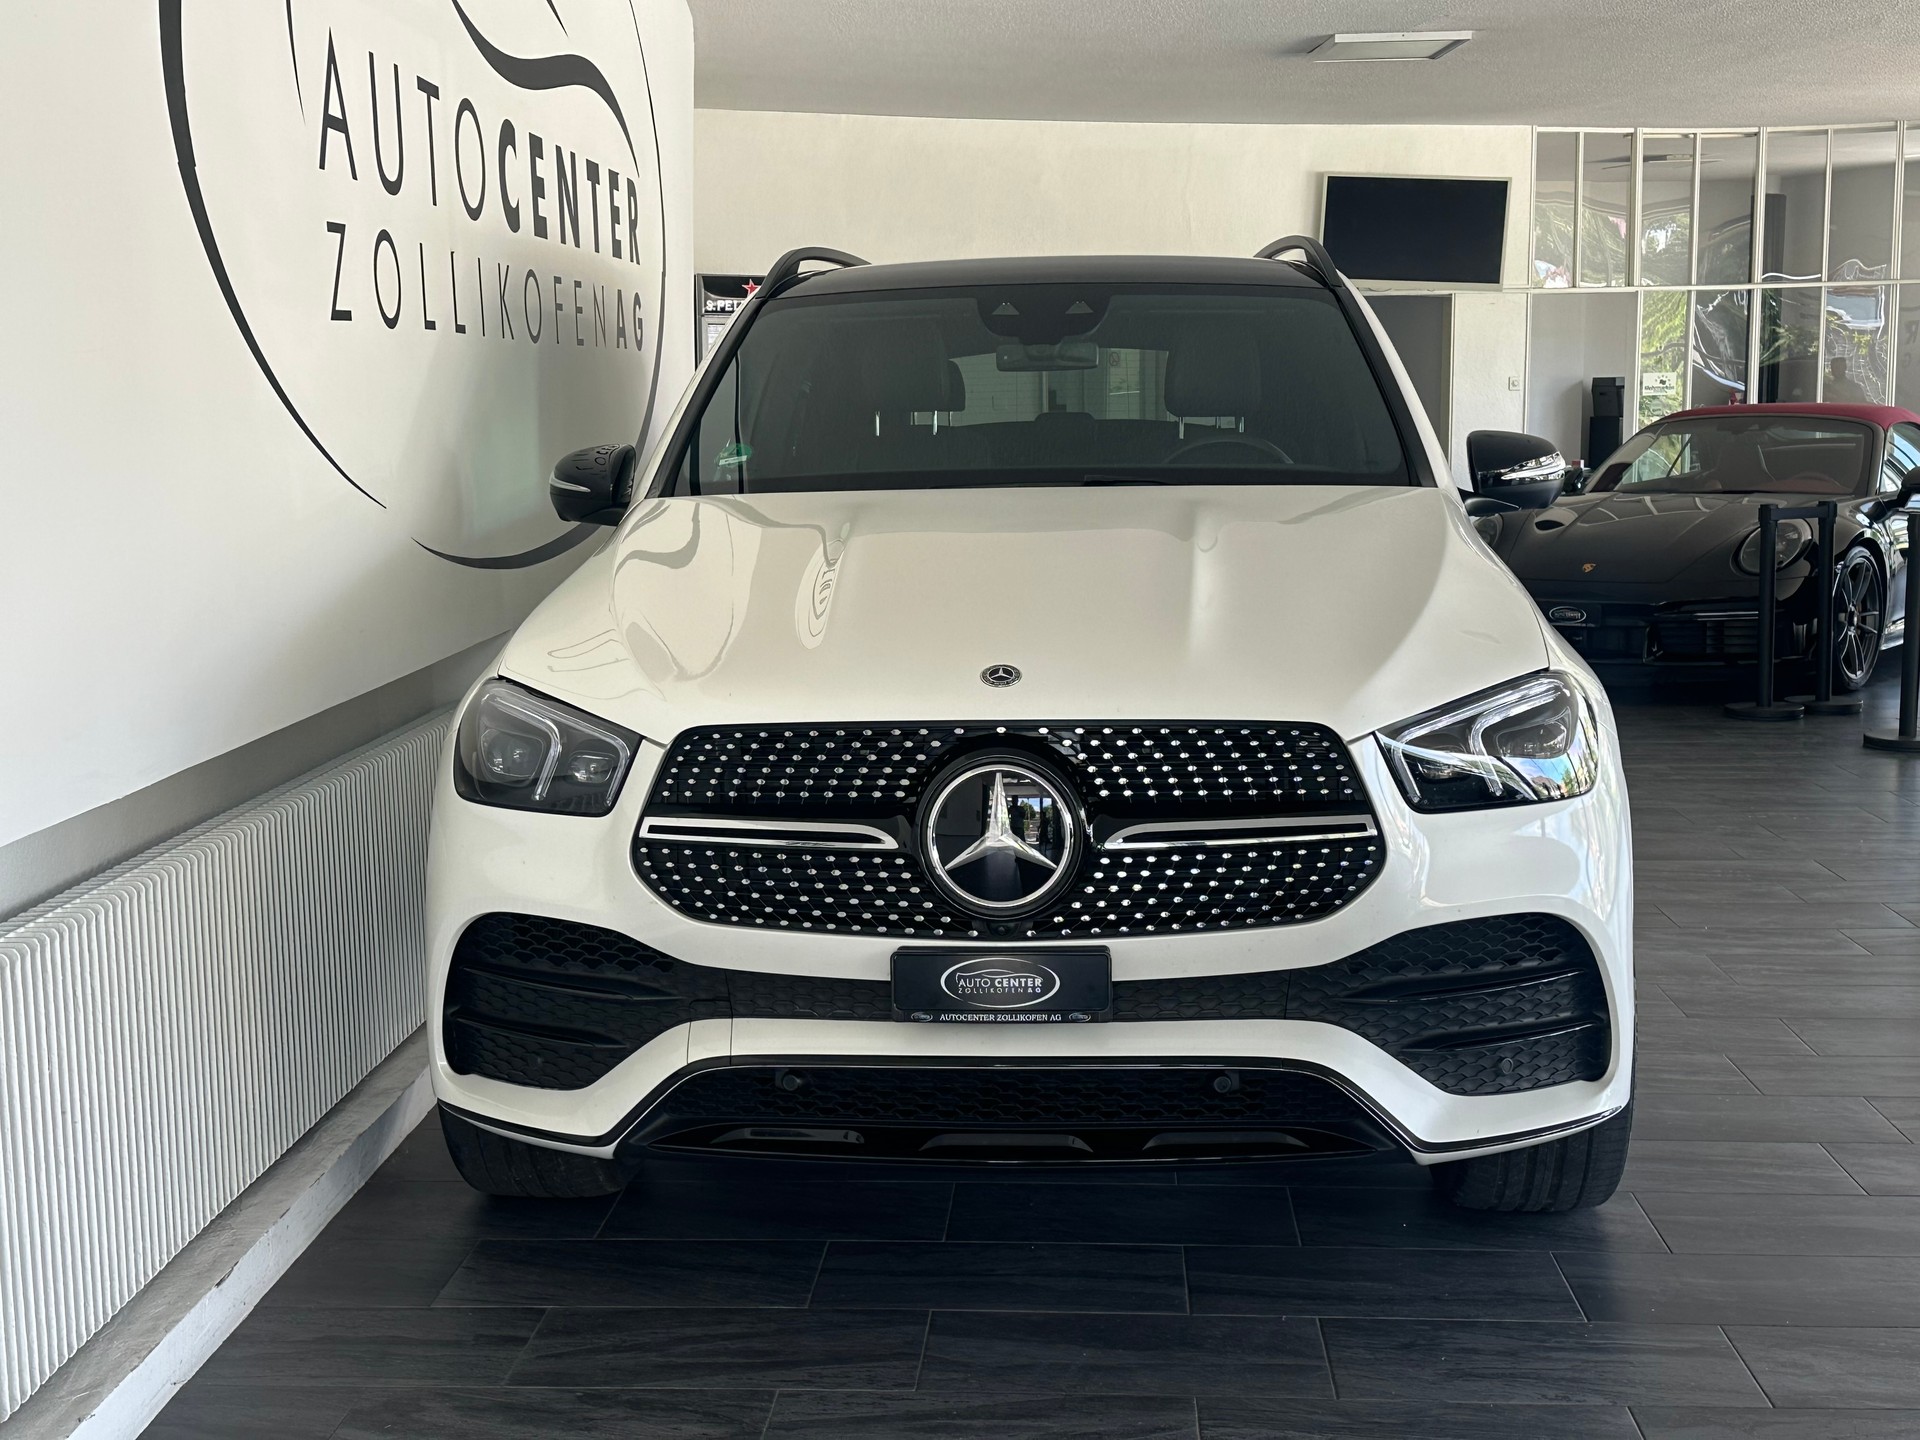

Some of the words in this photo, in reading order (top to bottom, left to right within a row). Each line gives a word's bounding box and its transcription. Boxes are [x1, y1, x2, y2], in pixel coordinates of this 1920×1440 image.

[958, 978, 991, 988] AUTO
[994, 978, 1042, 988] CENTER
[939, 1013, 995, 1021] AUTOCENTER
[996, 1013, 1048, 1021] ZOLLIKOFEN
[1050, 1013, 1062, 1021] AG
